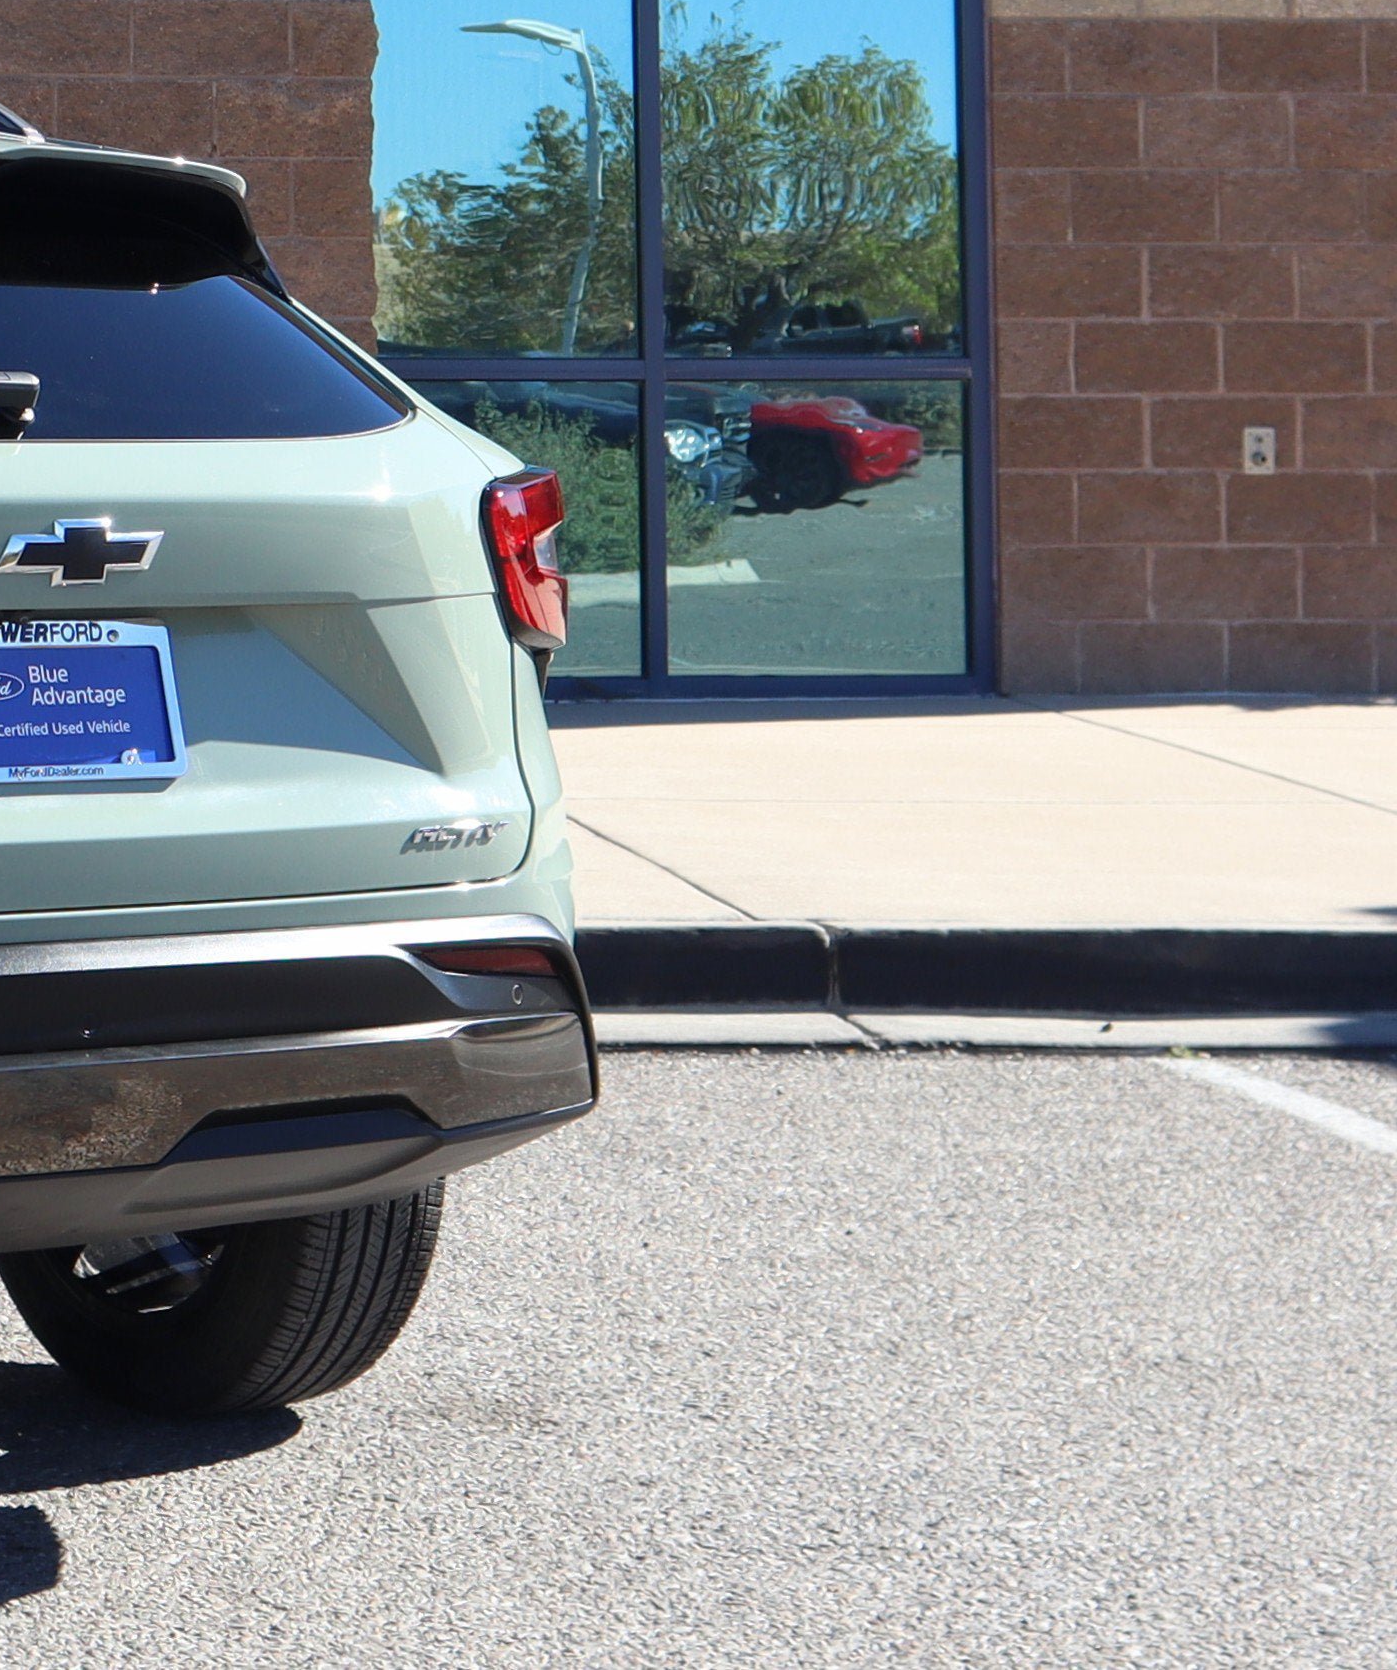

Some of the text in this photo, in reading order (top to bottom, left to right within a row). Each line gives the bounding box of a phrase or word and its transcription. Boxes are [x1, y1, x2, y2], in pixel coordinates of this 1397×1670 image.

[27, 666, 69, 684] Blue
[31, 685, 126, 708] Advantage
[52, 721, 84, 735] Used
[86, 718, 131, 734] Vehicle
